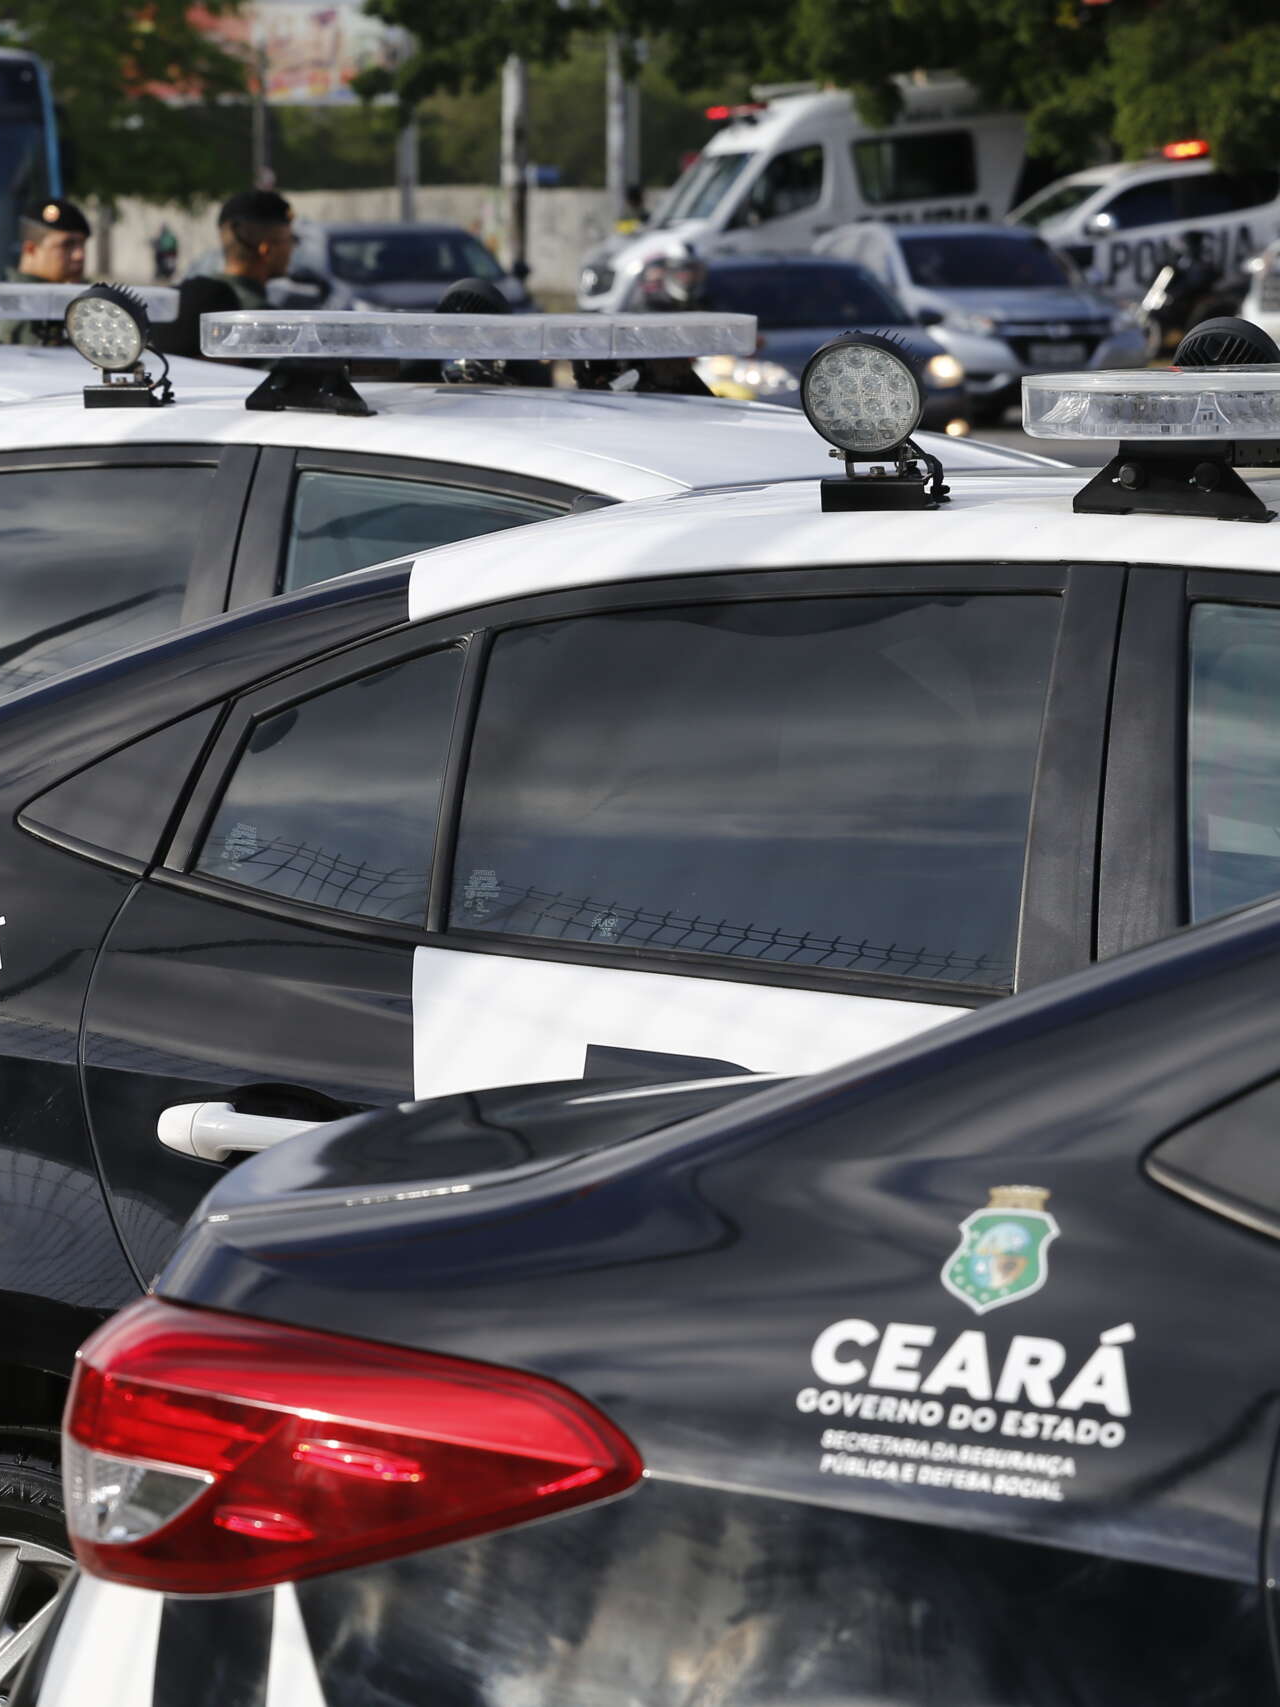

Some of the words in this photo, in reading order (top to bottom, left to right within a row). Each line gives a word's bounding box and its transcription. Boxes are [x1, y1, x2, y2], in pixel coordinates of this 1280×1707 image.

[811, 1318, 1135, 1417] CEARÁ
[796, 1387, 944, 1427] GOVERNO
[947, 1403, 997, 1432] DO
[1001, 1411, 1125, 1448] ESTADO
[821, 1452, 900, 1481] PÚBLICA
[901, 1463, 916, 1482] E
[918, 1465, 992, 1492] DEFESA
[993, 1474, 1064, 1501] SOCIAL
[822, 1428, 930, 1459] SECRETARIA
[931, 1443, 959, 1463] DA
[959, 1445, 1076, 1477] SEGURANÇA
